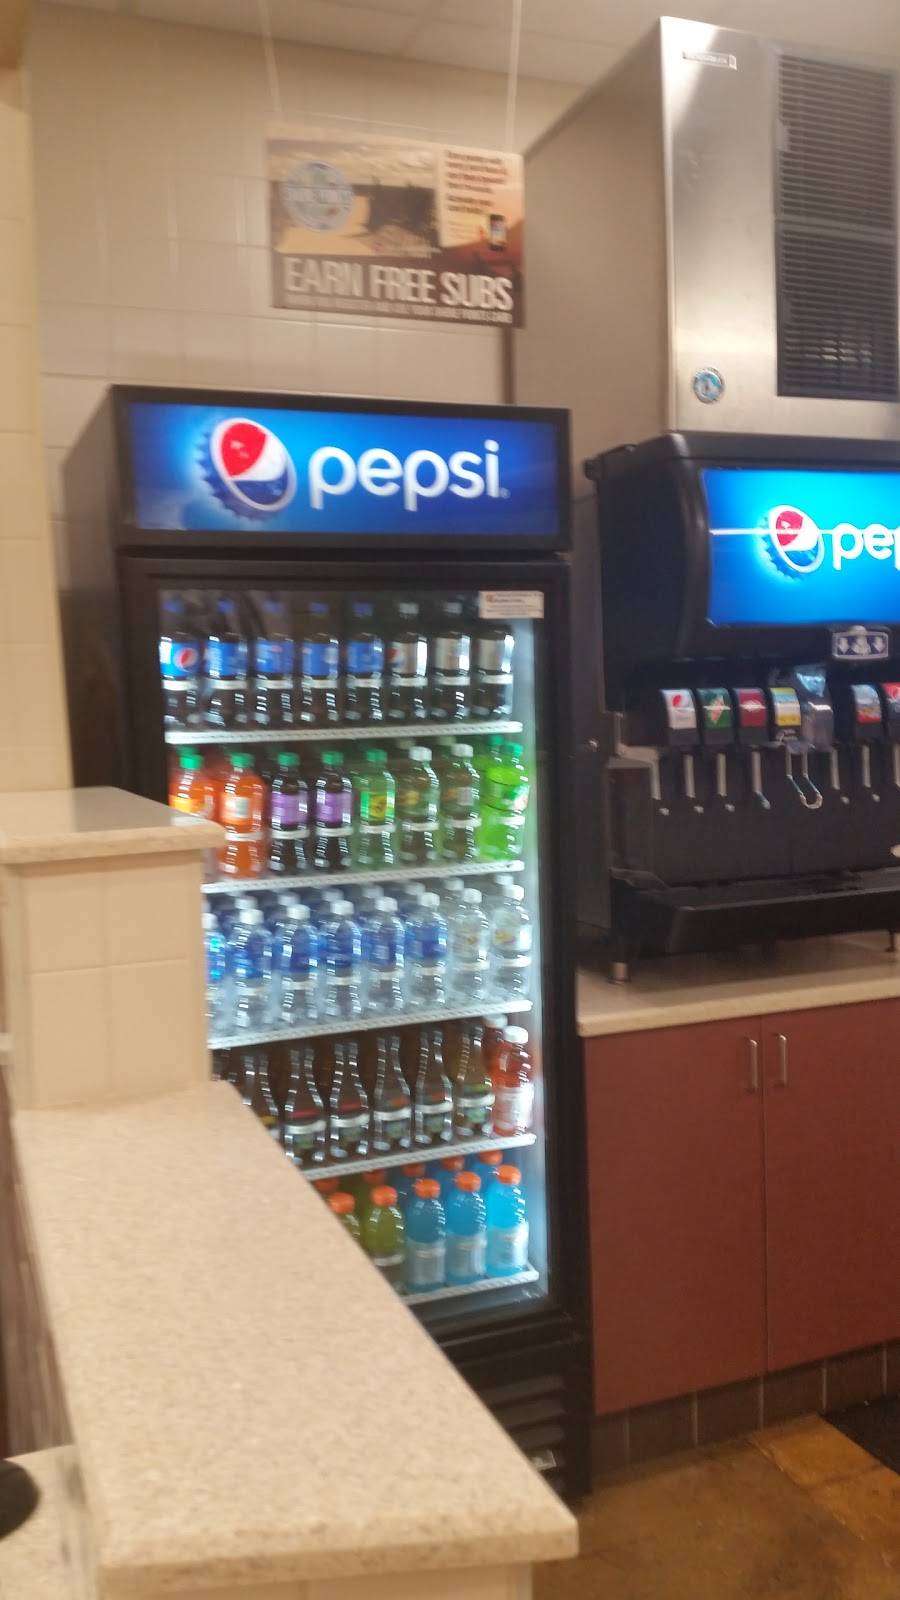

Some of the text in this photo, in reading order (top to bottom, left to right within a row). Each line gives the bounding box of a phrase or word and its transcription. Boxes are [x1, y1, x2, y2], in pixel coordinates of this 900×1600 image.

[286, 257, 363, 296] EARN
[369, 265, 436, 304] FREE
[440, 272, 514, 310] SUBS
[309, 439, 500, 511] pepsi
[832, 522, 900, 571] pe
